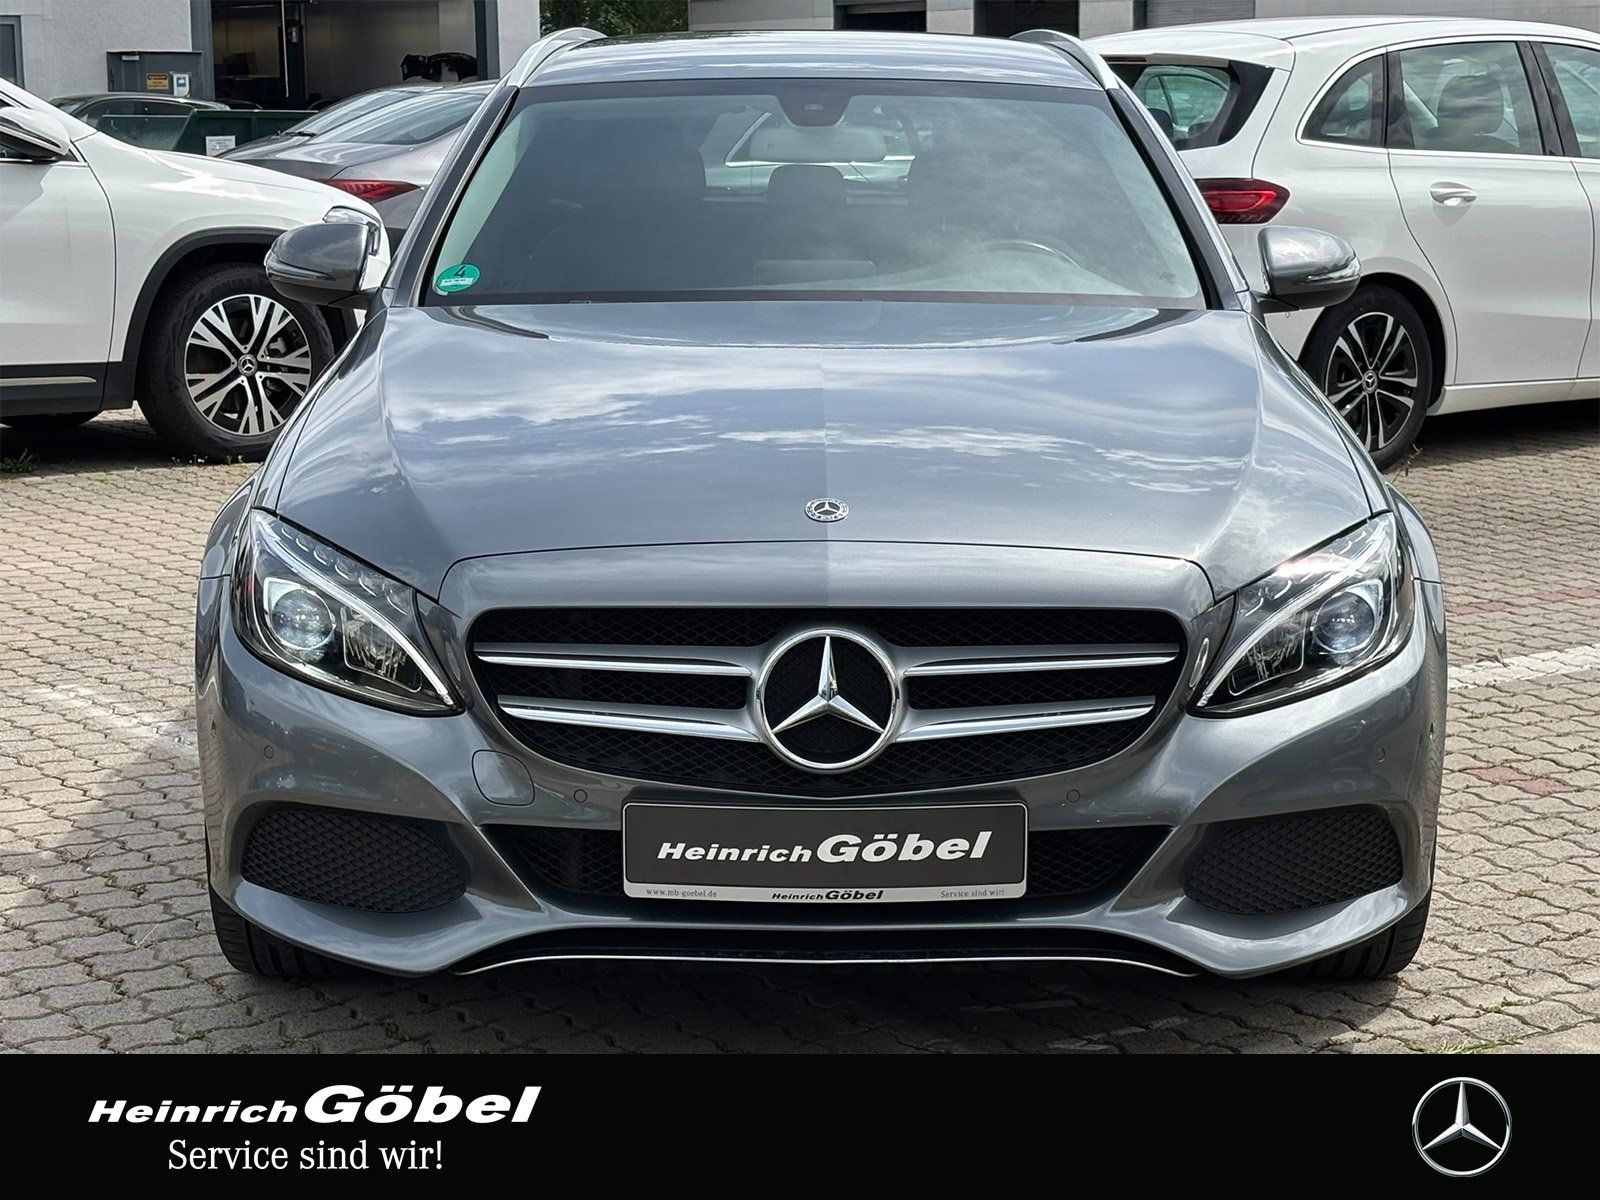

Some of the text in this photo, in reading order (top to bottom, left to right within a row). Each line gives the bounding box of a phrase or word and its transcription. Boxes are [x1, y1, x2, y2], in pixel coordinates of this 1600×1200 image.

[454, 266, 466, 277] 4
[646, 889, 718, 898] www.mb-goebel.de
[941, 888, 1005, 898] Service sind wir!
